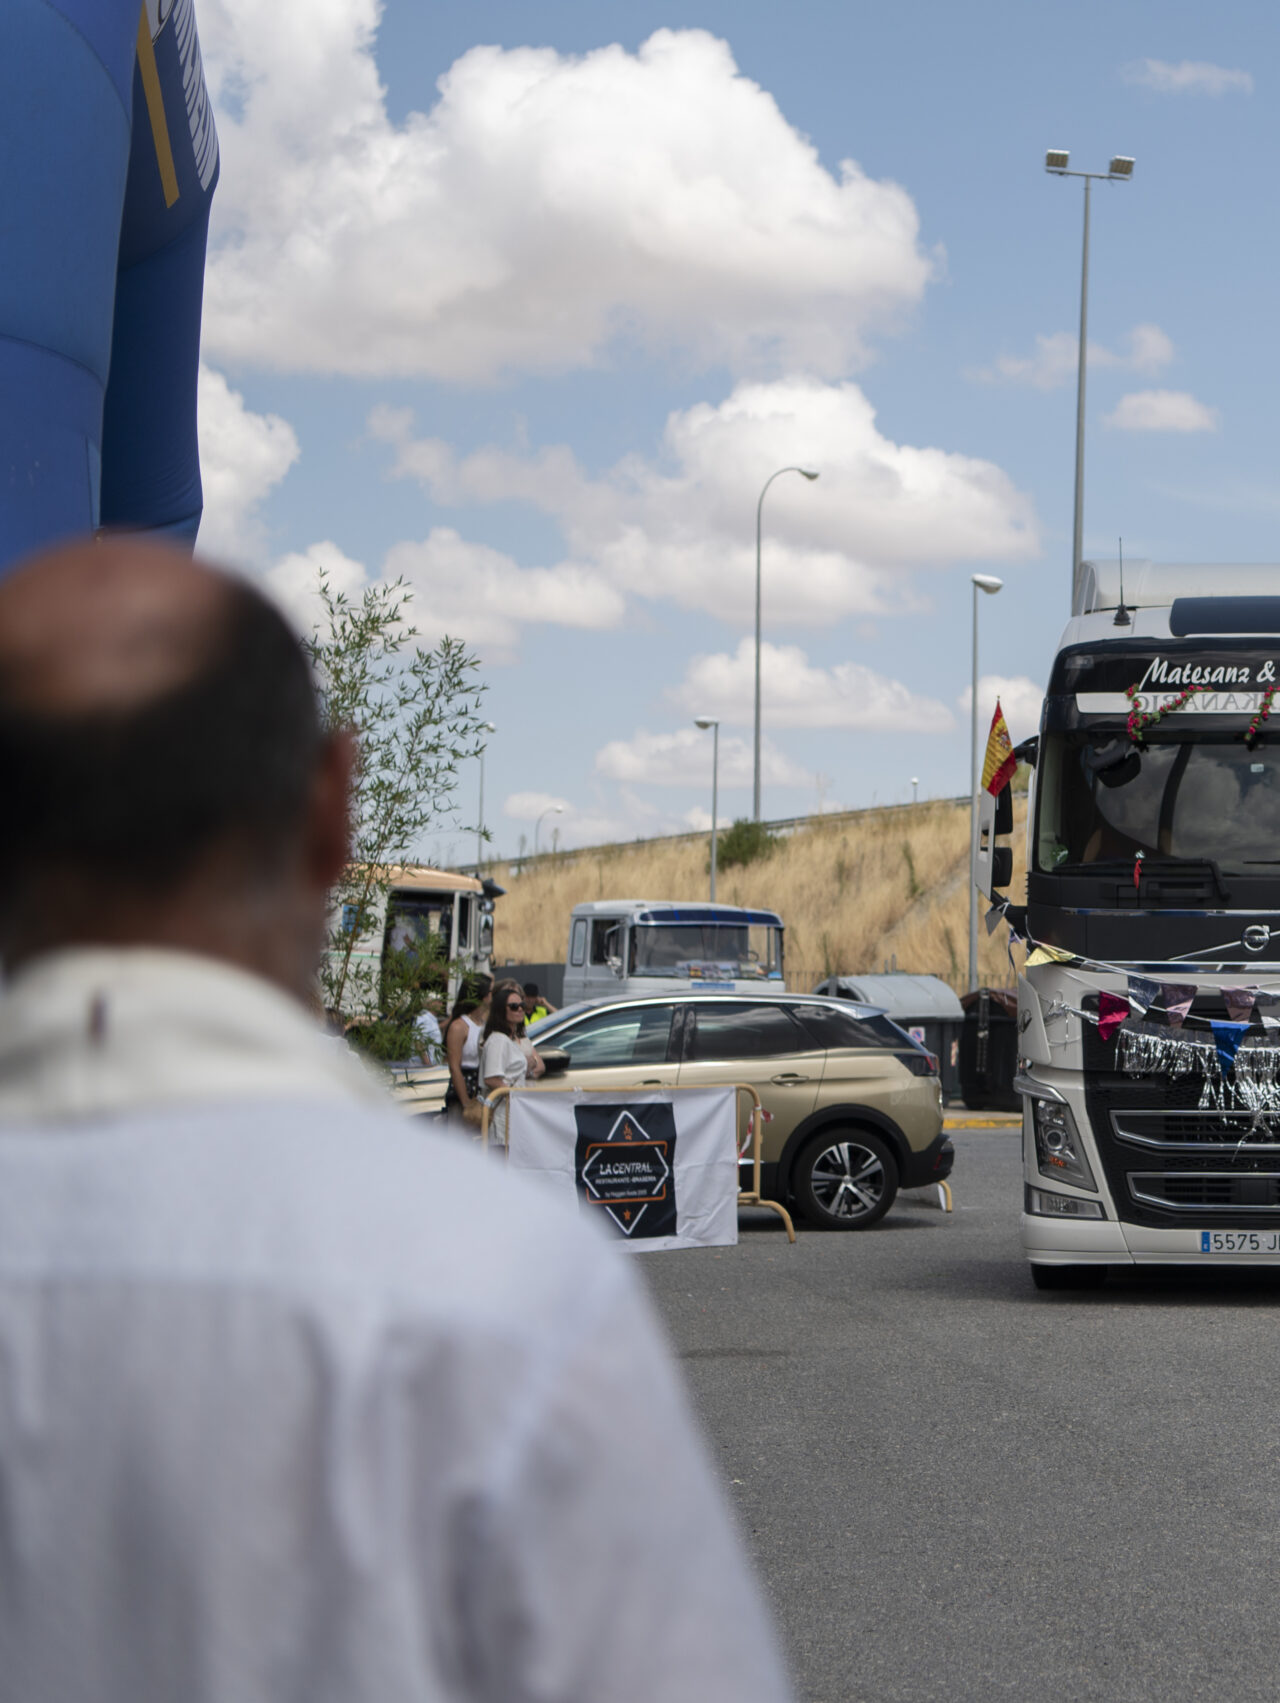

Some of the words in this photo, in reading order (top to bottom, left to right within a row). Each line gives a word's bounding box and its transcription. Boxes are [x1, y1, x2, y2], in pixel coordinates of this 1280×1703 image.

[1138, 656, 1250, 692] Matesanz
[1256, 660, 1276, 683] &
[600, 1163, 612, 1175] LA
[613, 1162, 652, 1175] CENTRAL
[1213, 1234, 1260, 1250] 5575
